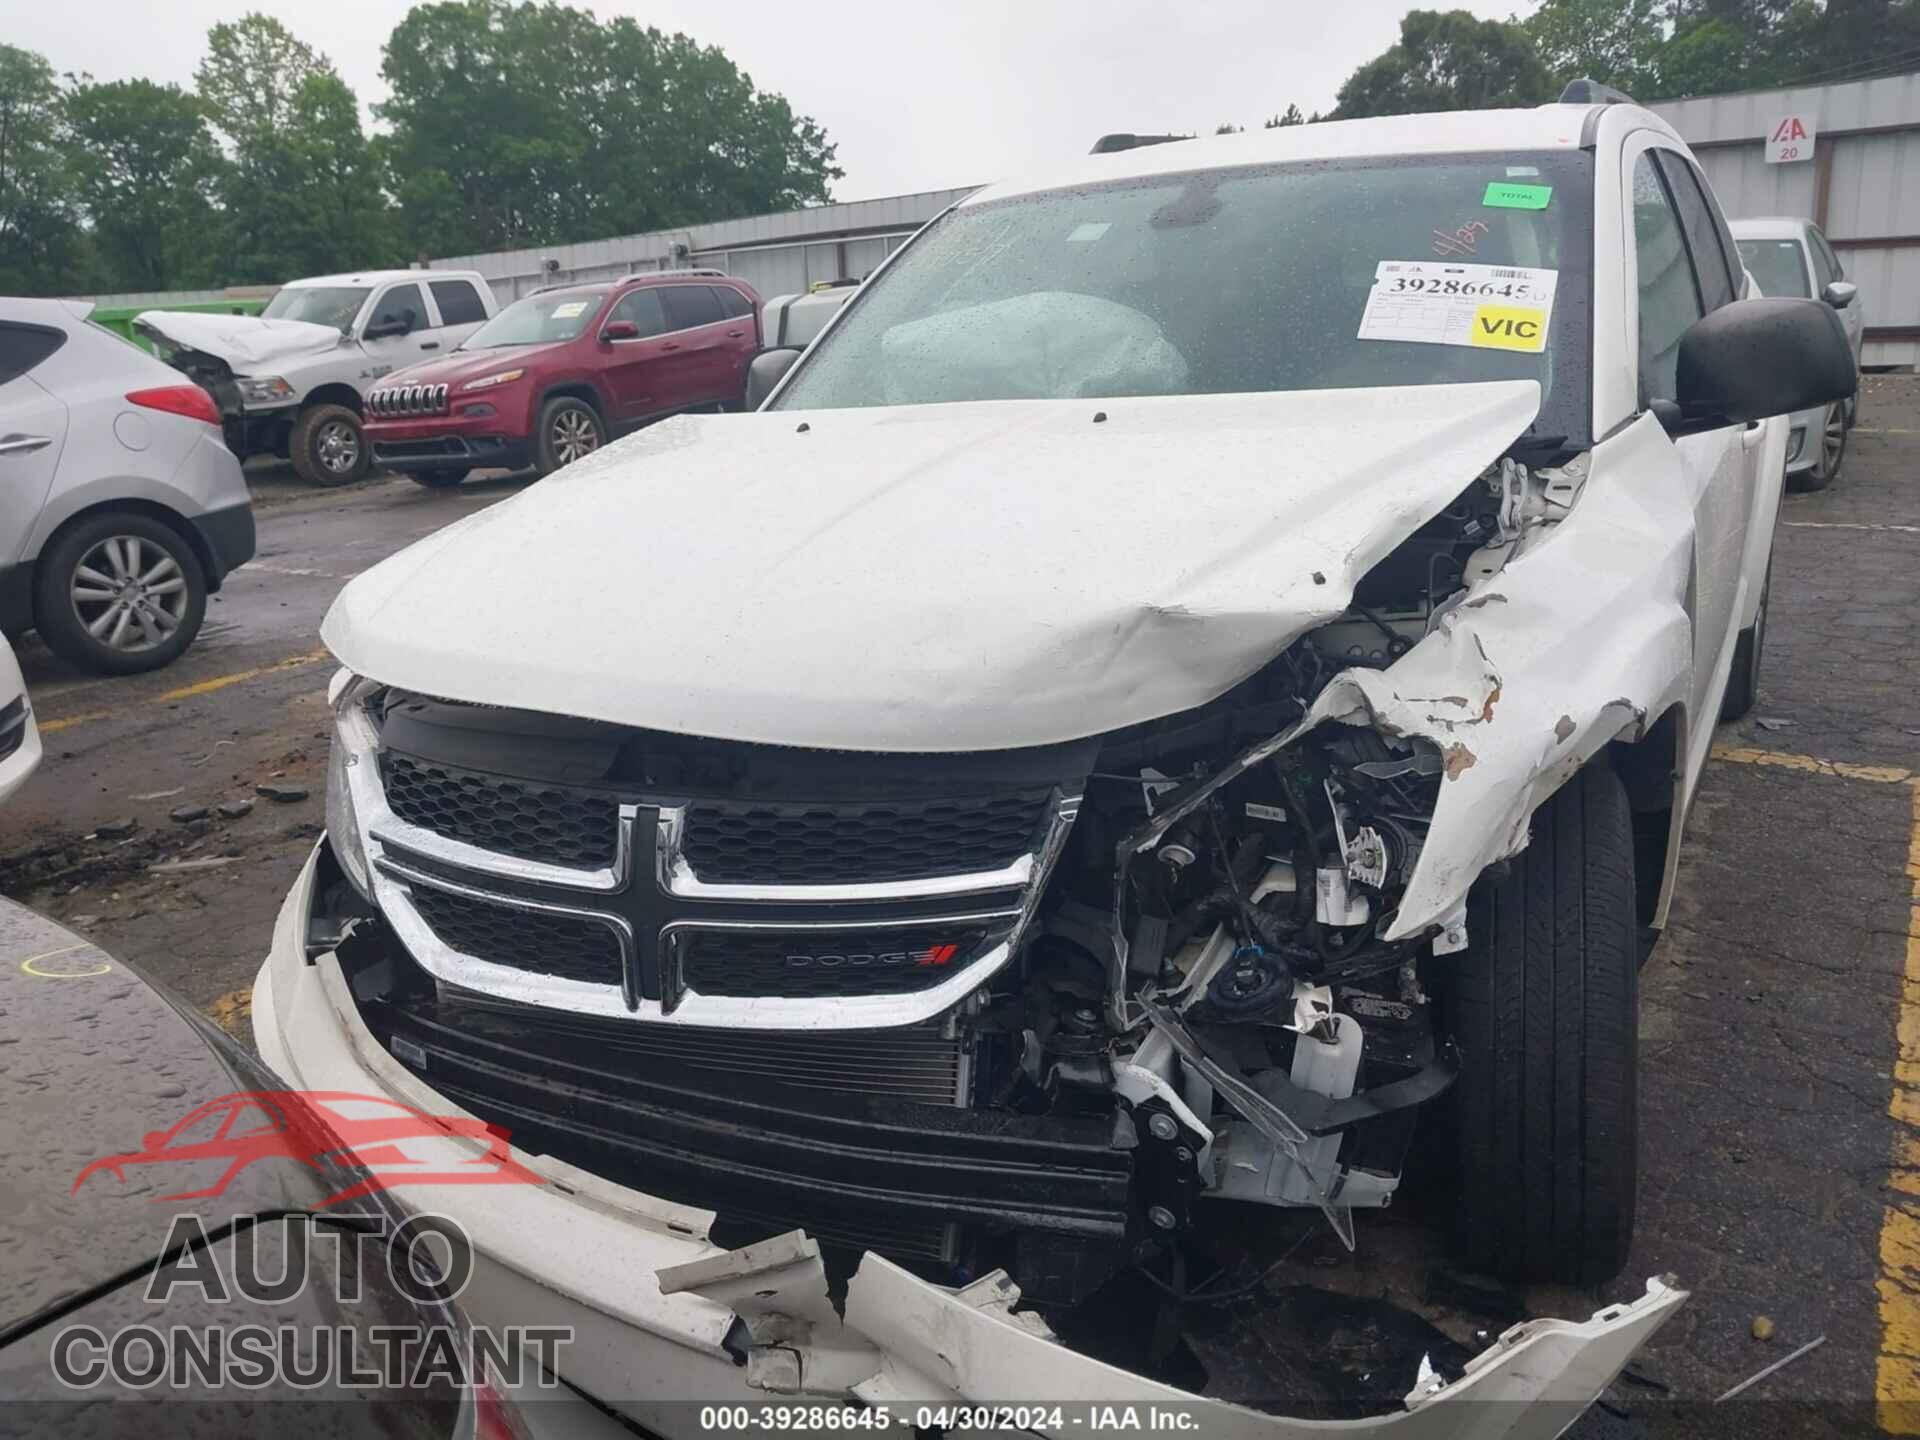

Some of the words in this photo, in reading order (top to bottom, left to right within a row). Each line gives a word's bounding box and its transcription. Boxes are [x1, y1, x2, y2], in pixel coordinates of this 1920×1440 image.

[1780, 147, 1798, 160] 20
[1481, 317, 1538, 338] VIC
[785, 951, 936, 967] DODGE
